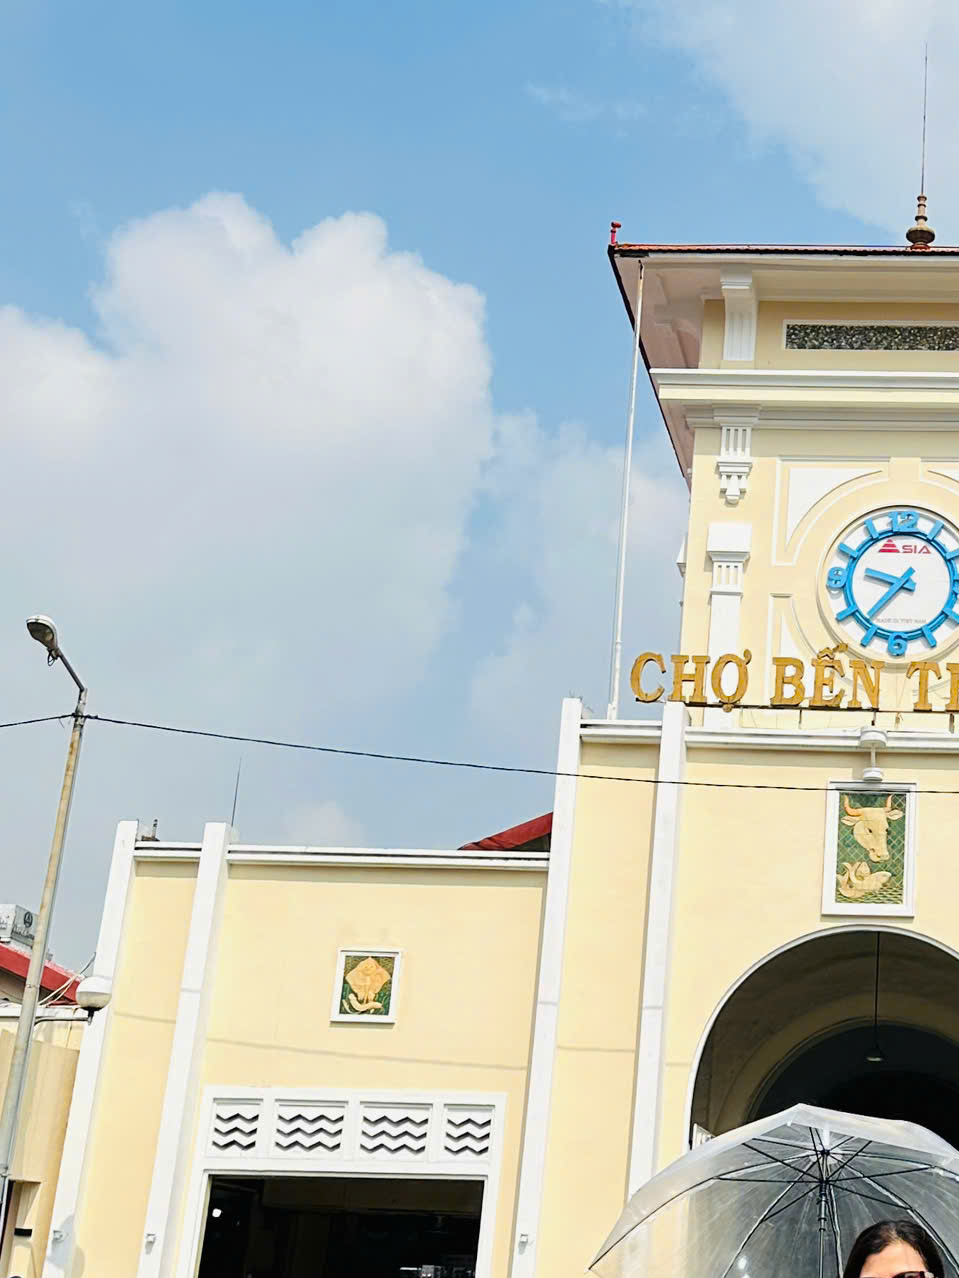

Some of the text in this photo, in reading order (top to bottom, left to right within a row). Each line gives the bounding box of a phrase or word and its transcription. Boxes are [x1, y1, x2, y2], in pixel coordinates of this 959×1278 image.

[888, 510, 920, 532] 12
[827, 566, 847, 589] 9
[887, 632, 907, 657] 6
[630, 649, 753, 712] CHỢ
[770, 643, 885, 710] BẾN
